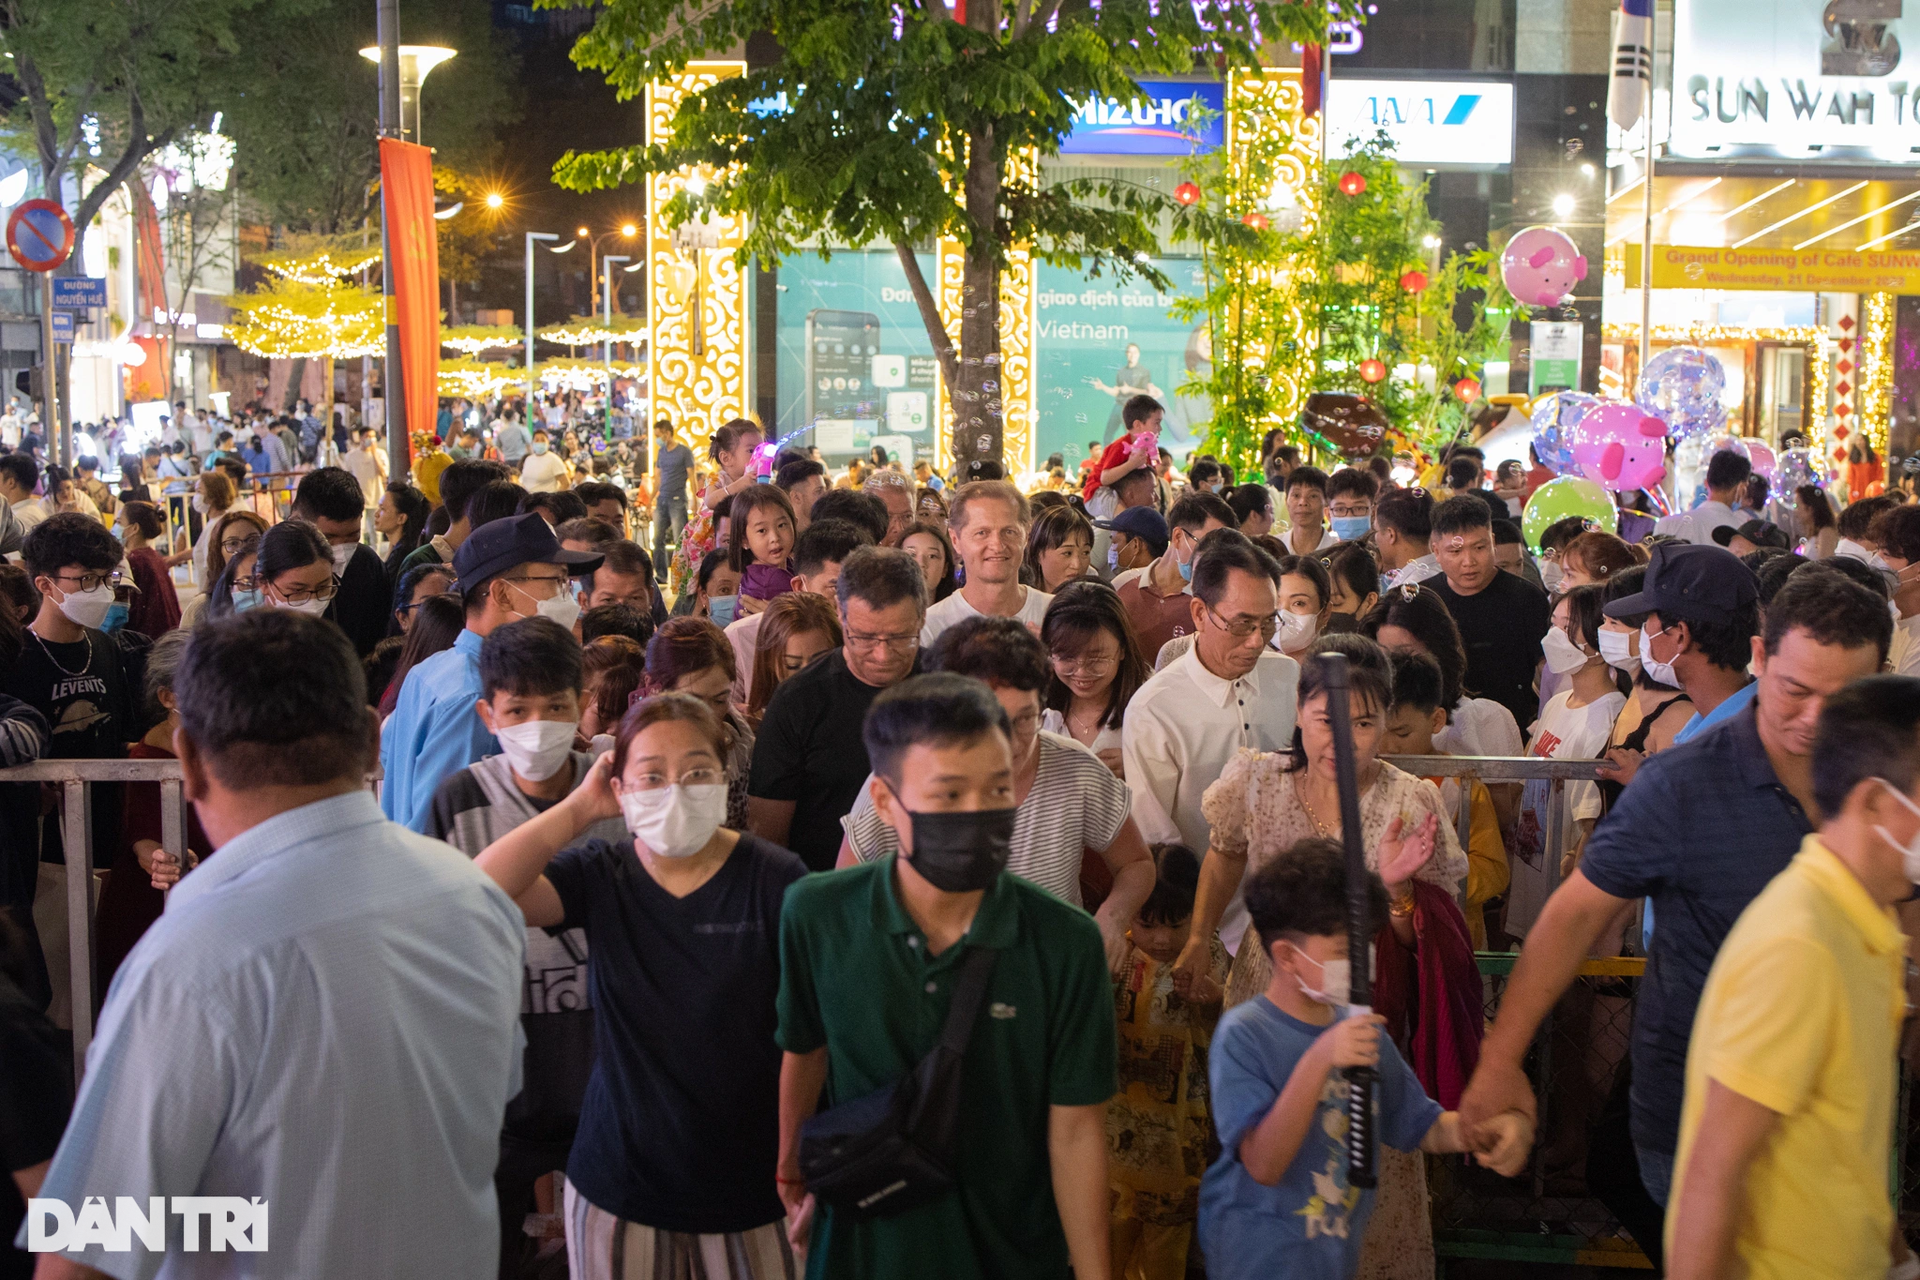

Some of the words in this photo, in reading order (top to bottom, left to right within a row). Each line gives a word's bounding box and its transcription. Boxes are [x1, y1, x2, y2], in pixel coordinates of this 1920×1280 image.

[1687, 74, 1768, 124] SUN
[1781, 77, 1875, 125] WAH
[1354, 97, 1434, 124] ANA
[1666, 249, 1719, 264] Grand
[1724, 250, 1797, 269] Opening
[1802, 253, 1819, 266] of
[63, 280, 96, 290] ĐƯỜNG
[1788, 273, 1802, 284] 21
[1806, 274, 1871, 287] December
[1038, 289, 1077, 309] giao
[1080, 289, 1118, 310] dịch
[1122, 289, 1154, 307] của
[1036, 319, 1129, 339] Vietnam
[51, 678, 106, 701] LEVENTS
